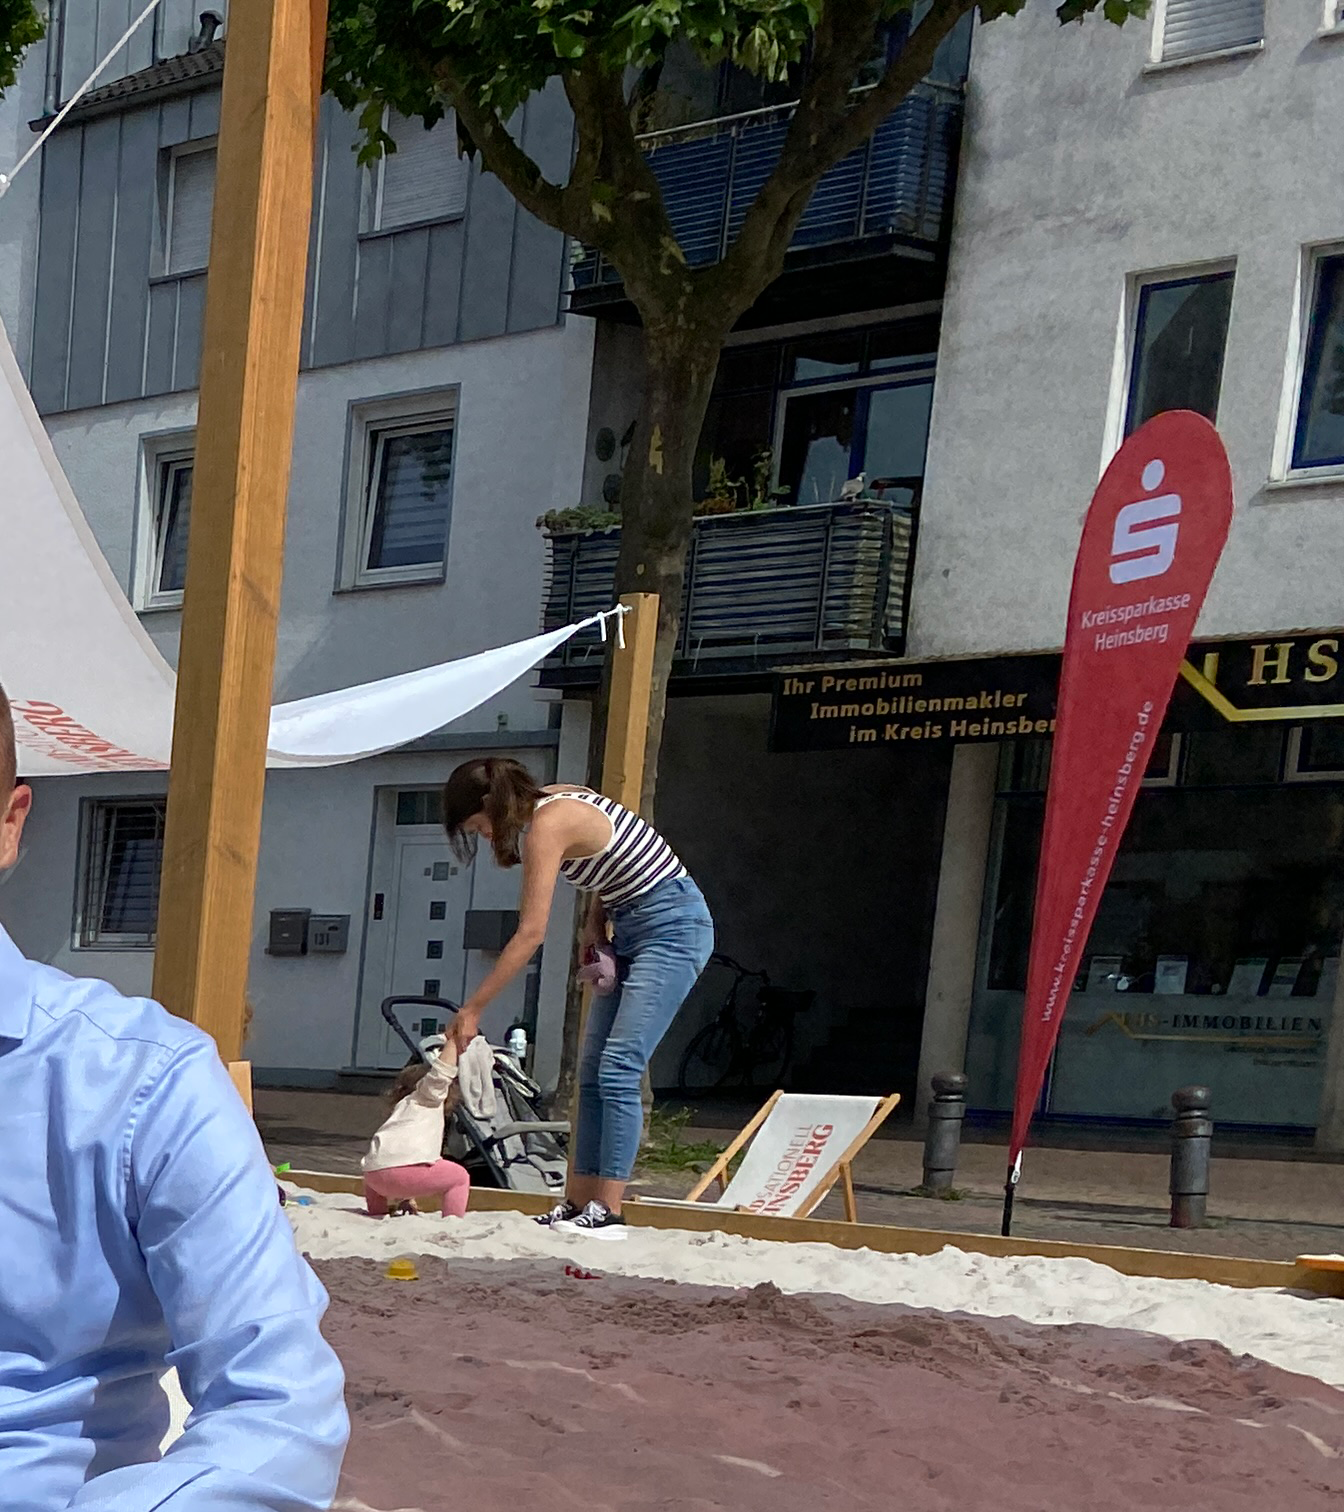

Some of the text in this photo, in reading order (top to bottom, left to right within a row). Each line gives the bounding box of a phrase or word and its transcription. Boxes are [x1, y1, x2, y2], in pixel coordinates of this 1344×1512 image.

[1081, 593, 1192, 630] Kreissparkasse
[1094, 623, 1170, 652] Heinsberg
[782, 673, 923, 696] Ihr Premium
[809, 691, 1029, 720] Immobilienmakler
[848, 715, 1058, 743] im Kreis Heinsber
[1040, 700, 1154, 1023] www.kreissparkasse-heinsberg.de
